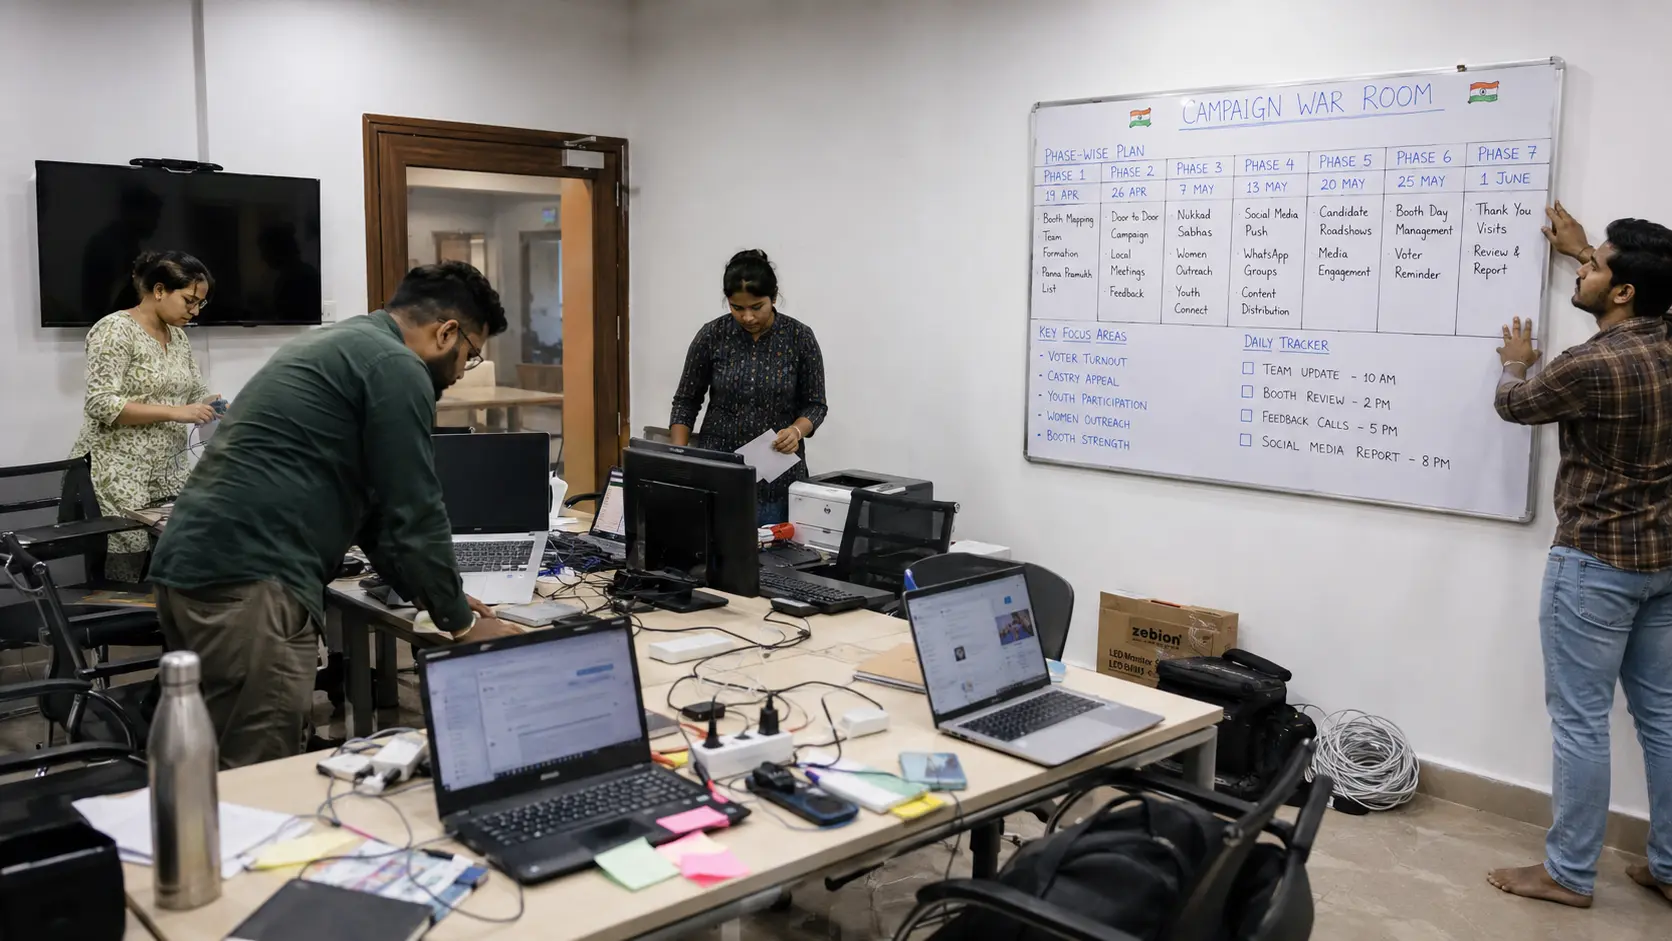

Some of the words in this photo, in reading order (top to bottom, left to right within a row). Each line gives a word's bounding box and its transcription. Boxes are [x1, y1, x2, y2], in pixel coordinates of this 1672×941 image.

[1183, 95, 1283, 125] CAMPAIGN
[1297, 91, 1344, 116] WAR
[1363, 83, 1432, 111] ROOM
[1045, 148, 1108, 164] PHASE-WISE
[1117, 144, 1145, 159] PLAN
[1397, 150, 1438, 165] PHASE
[1444, 150, 1452, 163] 6
[1478, 146, 1519, 161] PHASE
[1529, 145, 1537, 160] 7
[1176, 161, 1208, 175] PHASE
[1215, 161, 1222, 173] 3
[1245, 158, 1279, 172] PHASE
[1285, 158, 1294, 171] 4
[1319, 154, 1356, 169] PHASE
[1364, 154, 1372, 167] 5
[1044, 169, 1073, 182] PHASE
[1079, 170, 1086, 180] 1
[1110, 166, 1141, 179] PHASE
[1147, 166, 1154, 177] 2
[1480, 173, 1488, 185] 1
[1496, 171, 1530, 184] JUNE
[1247, 182, 1260, 194] 13
[1265, 181, 1288, 193] MAY
[1321, 178, 1336, 190] 20
[1342, 178, 1365, 190] MAY
[1398, 176, 1414, 188] 25
[1420, 174, 1446, 187] MAY
[1045, 190, 1055, 201] 19
[1061, 190, 1080, 200] APR
[1111, 187, 1124, 198] 26
[1129, 187, 1147, 197] APR
[1180, 184, 1187, 195] 7
[1193, 183, 1215, 195] MAY
[1177, 208, 1211, 220] Nukkad
[1244, 208, 1269, 220] Social
[1274, 208, 1299, 220] Media
[1319, 205, 1368, 218] Candidate
[1396, 204, 1424, 218] Booth
[1429, 204, 1448, 222] Day
[1475, 202, 1508, 216] Thank
[1514, 201, 1532, 216] You
[1043, 213, 1063, 224] Booth
[1111, 210, 1128, 222] Door
[1132, 211, 1139, 222] to
[1142, 210, 1159, 222] Door
[1178, 225, 1213, 237] Sabhas
[1245, 225, 1268, 237] Push
[1320, 223, 1372, 236] Roadshows
[1395, 224, 1454, 241] Management
[1476, 222, 1507, 235] Visits
[1042, 230, 1062, 241] Team
[1111, 229, 1149, 244] Campaign
[1043, 247, 1079, 258] Formation
[1111, 249, 1132, 260] Local
[1176, 248, 1207, 259] Women
[1243, 247, 1289, 264] WhatsApp
[1318, 247, 1349, 259] Media
[1395, 247, 1423, 260] Voter
[1474, 244, 1508, 257] Review
[1513, 245, 1521, 257] &
[1042, 266, 1061, 278] Panna
[1110, 265, 1146, 281] Meetings
[1176, 264, 1213, 277] Outreach
[1244, 266, 1277, 280] Groups
[1318, 264, 1371, 281] Engagement
[1395, 265, 1441, 280] Reminder
[1474, 262, 1508, 280] Report
[1042, 283, 1056, 293] List
[1110, 287, 1145, 299] Feedback
[1175, 287, 1201, 298] Youth
[1241, 288, 1276, 299] Content
[1174, 303, 1209, 315] Connect
[1241, 303, 1290, 316] Distribution
[1039, 326, 1057, 339] KEY
[1063, 327, 1091, 340] FOCUS
[1097, 329, 1127, 342] AREAS
[1244, 335, 1273, 349] DAILY
[1279, 336, 1329, 351] TRACKER
[1048, 351, 1077, 363] VOTER
[1083, 353, 1128, 367] TURNOUT
[1048, 371, 1080, 384] CASTRY
[1085, 374, 1120, 387] APPEAL
[1263, 363, 1292, 376] TEAM
[1301, 367, 1340, 380] UPDATE
[1364, 373, 1376, 383] 10
[1379, 374, 1396, 385] AM
[1048, 391, 1075, 404] YOUTH
[1082, 393, 1148, 410] PARTICIPATION
[1263, 387, 1296, 400] BOOTH
[1307, 391, 1344, 405] REVIEW
[1364, 398, 1371, 408] 2
[1376, 399, 1391, 410] PM
[1047, 411, 1079, 423] WOMEN
[1085, 414, 1130, 429] OUTREACH
[1263, 411, 1308, 425] FEEDBACK
[1317, 417, 1349, 430] CALLS
[1370, 424, 1377, 434] 5
[1382, 425, 1398, 436] PM
[1047, 430, 1075, 443] BOOTH
[1082, 435, 1130, 450] STRENGTH
[1262, 436, 1299, 451] SOCIAL
[1310, 442, 1344, 456] MEDIA
[1356, 446, 1400, 462] REPORT
[1422, 455, 1429, 467] 8
[1434, 457, 1451, 469] PM
[1132, 627, 1181, 645] zebion
[1109, 649, 1123, 659] LED
